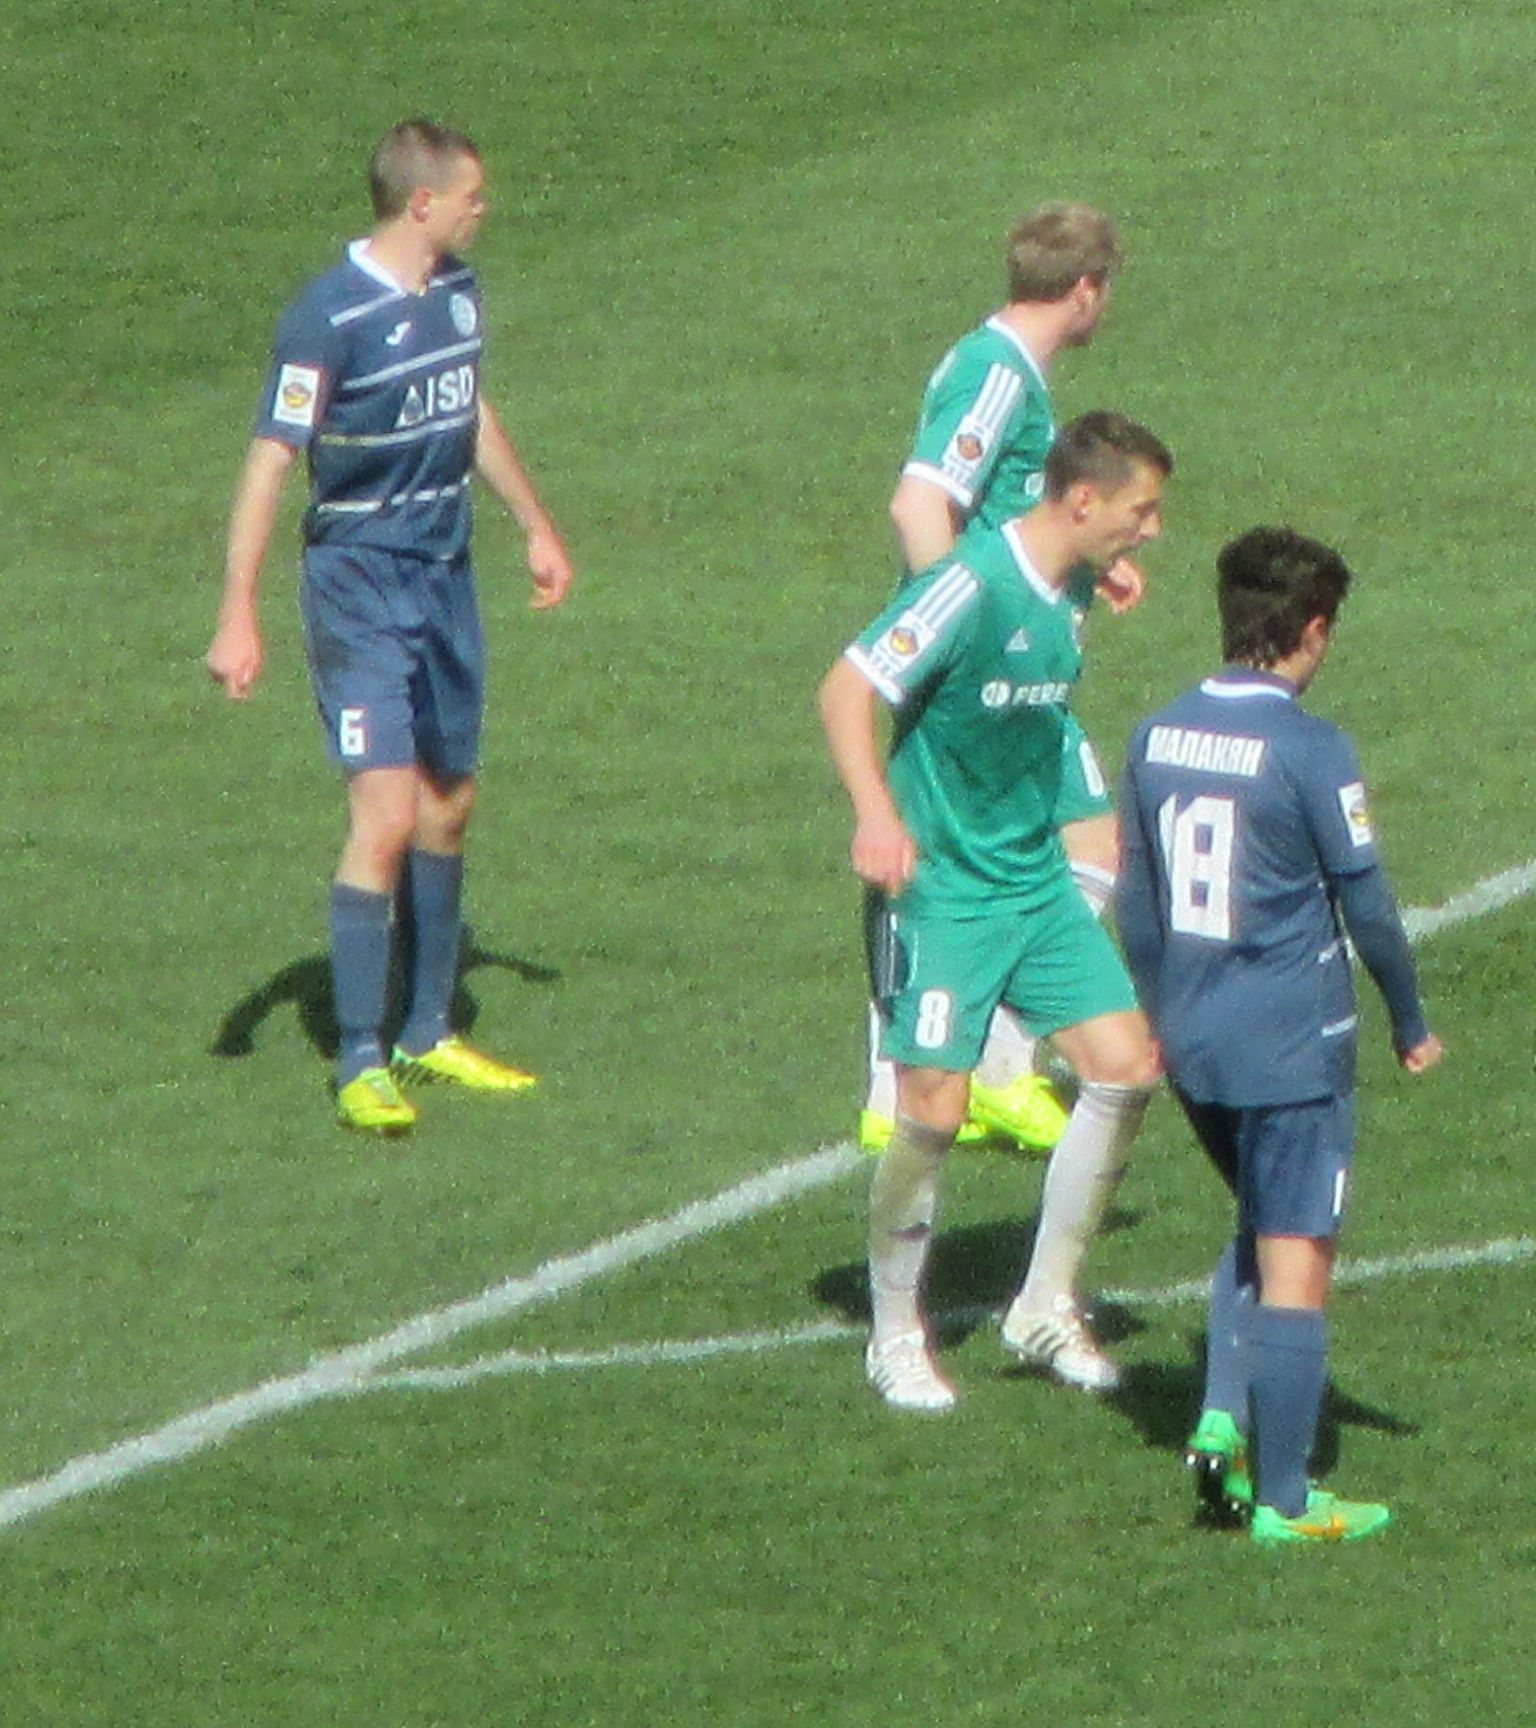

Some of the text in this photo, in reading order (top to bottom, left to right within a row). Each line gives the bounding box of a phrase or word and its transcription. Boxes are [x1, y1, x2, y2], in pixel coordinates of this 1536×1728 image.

[340, 708, 364, 756] 6
[1159, 791, 1235, 941] 18
[915, 989, 951, 1049] 8
